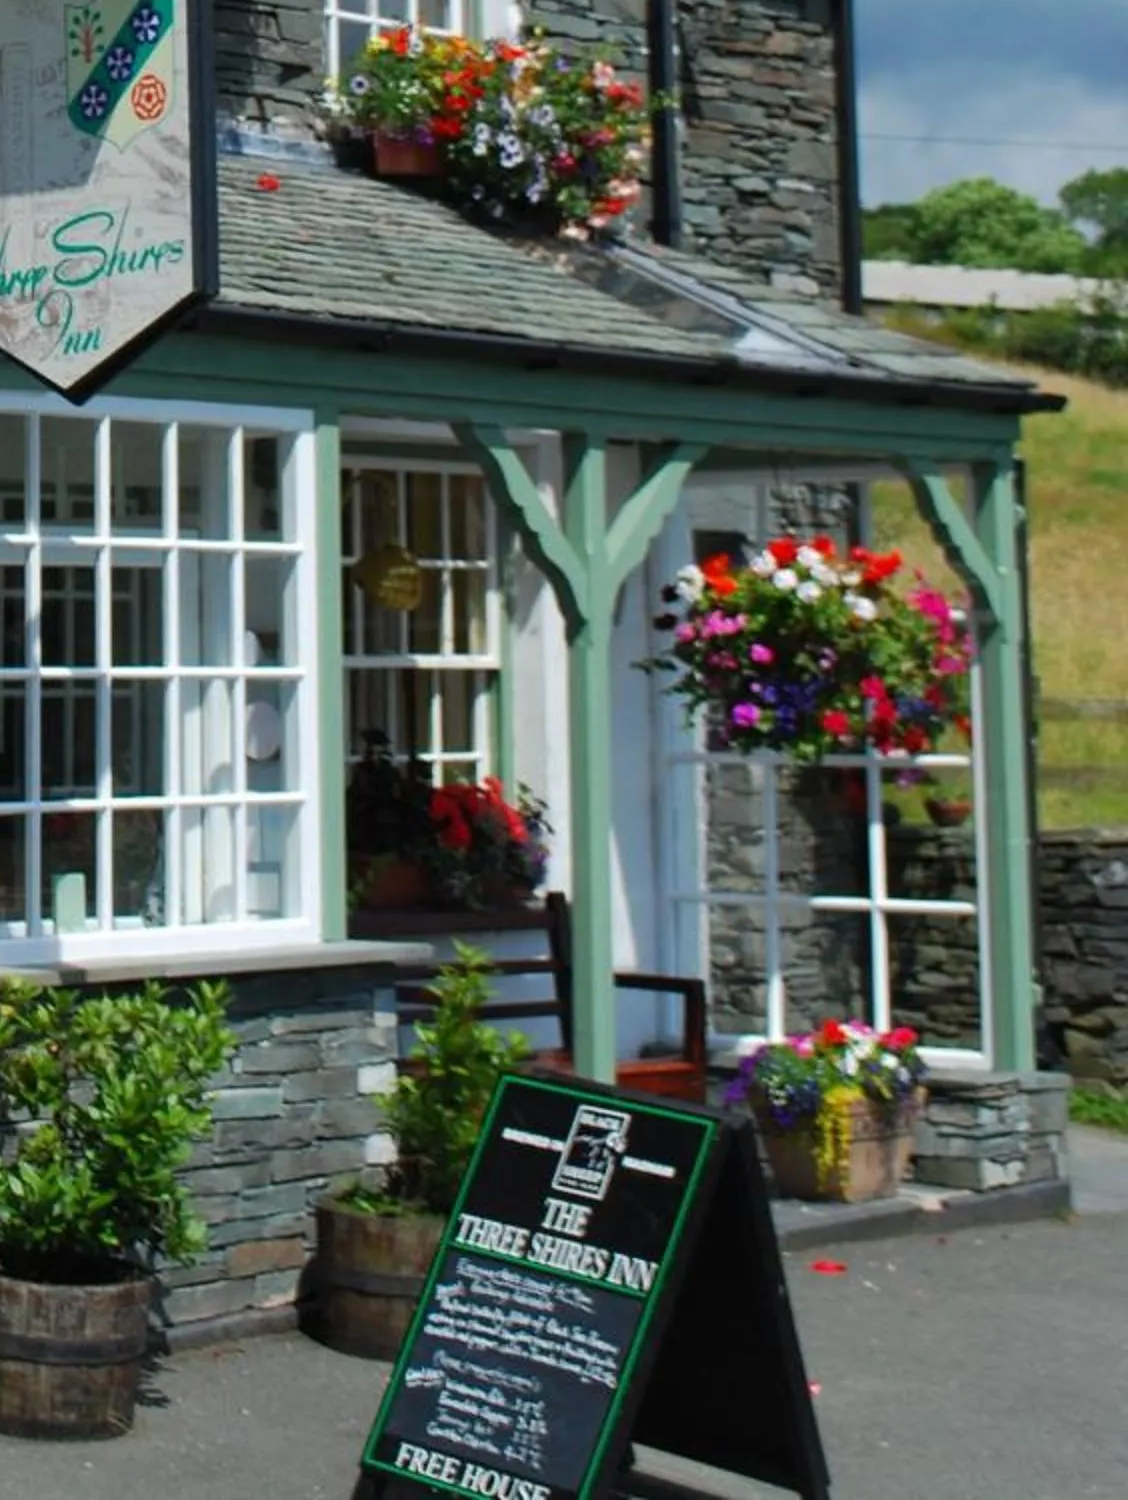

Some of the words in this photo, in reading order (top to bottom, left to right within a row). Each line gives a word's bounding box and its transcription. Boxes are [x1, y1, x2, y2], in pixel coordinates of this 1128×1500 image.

[52, 199, 185, 287] Shires
[36, 289, 101, 362] Inn
[456, 1213, 531, 1258] THREE
[527, 1231, 610, 1279] SHIRES
[605, 1252, 660, 1292] INN
[542, 1197, 593, 1237] THE
[395, 1442, 460, 1483] FREE
[460, 1462, 552, 1500] HOUSE
